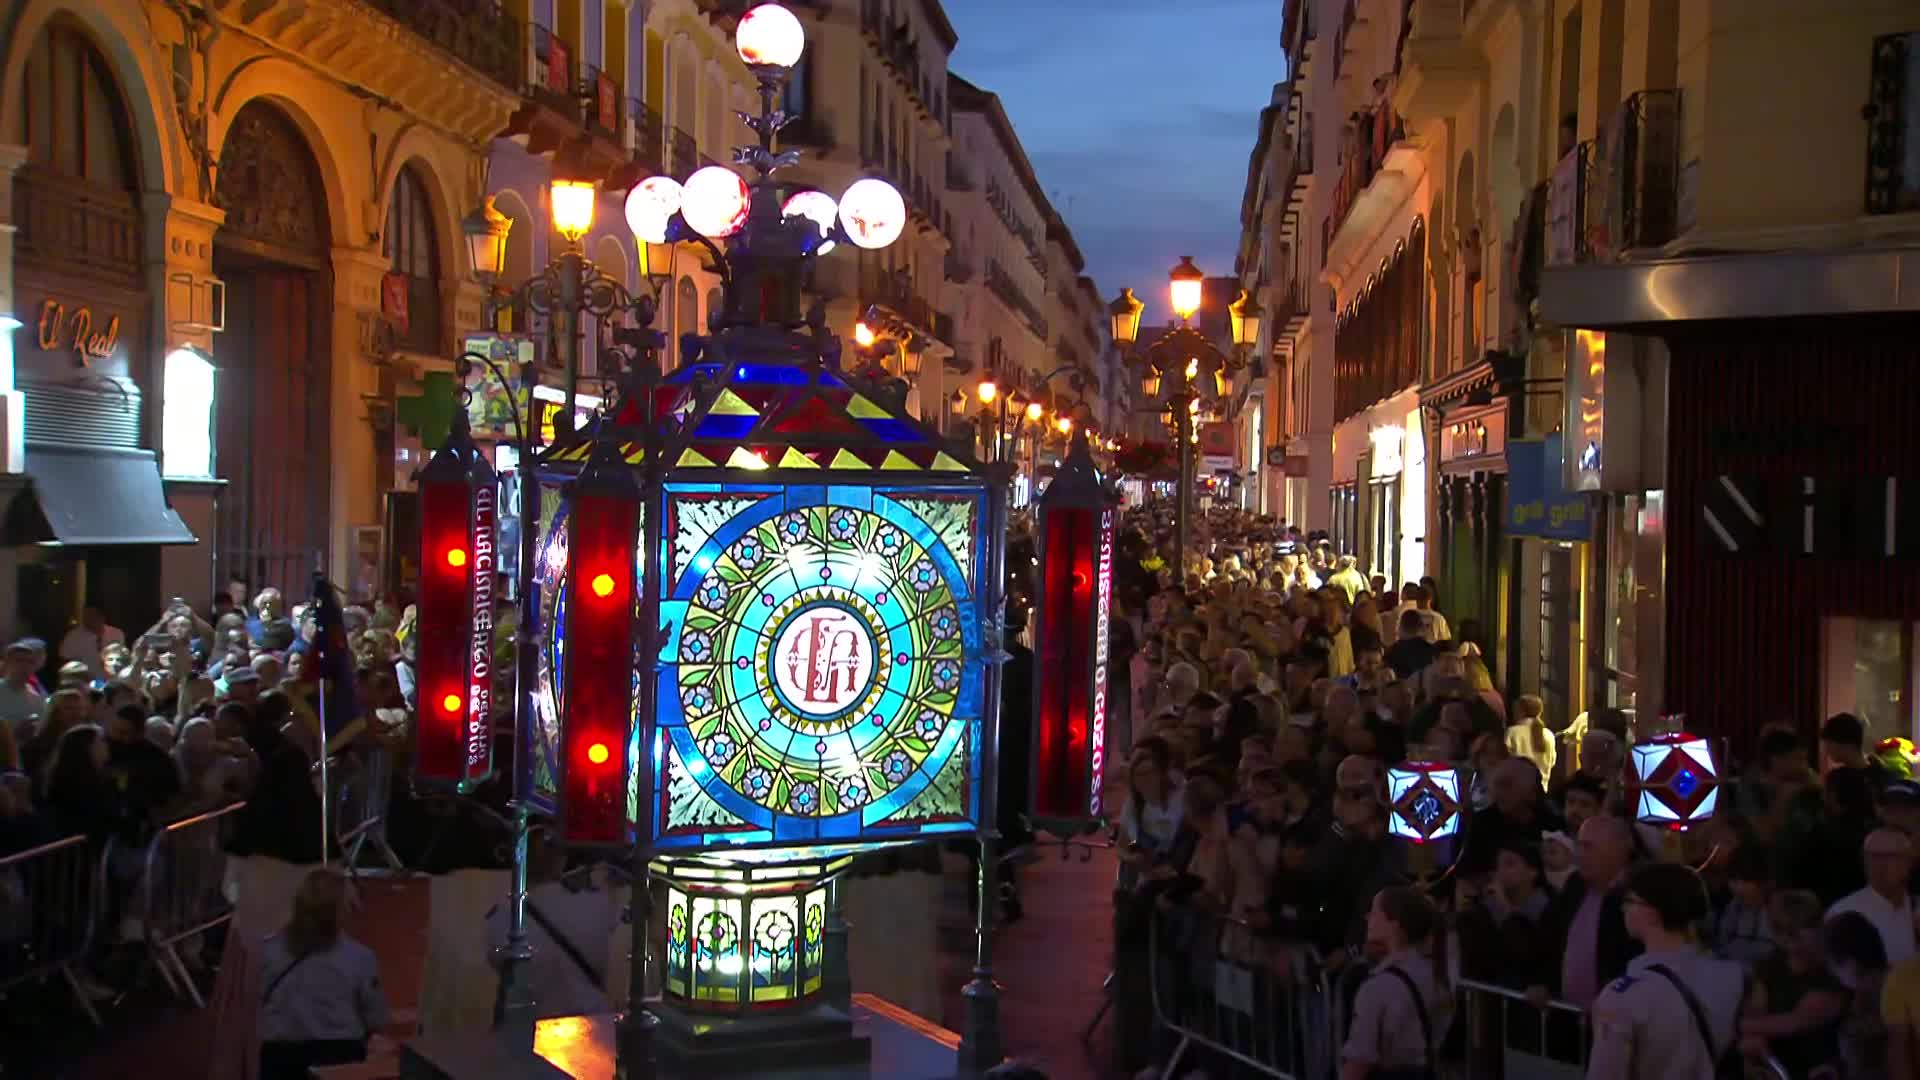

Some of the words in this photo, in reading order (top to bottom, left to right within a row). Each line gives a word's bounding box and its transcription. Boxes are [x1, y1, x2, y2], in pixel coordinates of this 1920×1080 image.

[39, 299, 64, 350] El
[73, 305, 119, 368] Real
[1090, 691, 1105, 816] GOZOSO
